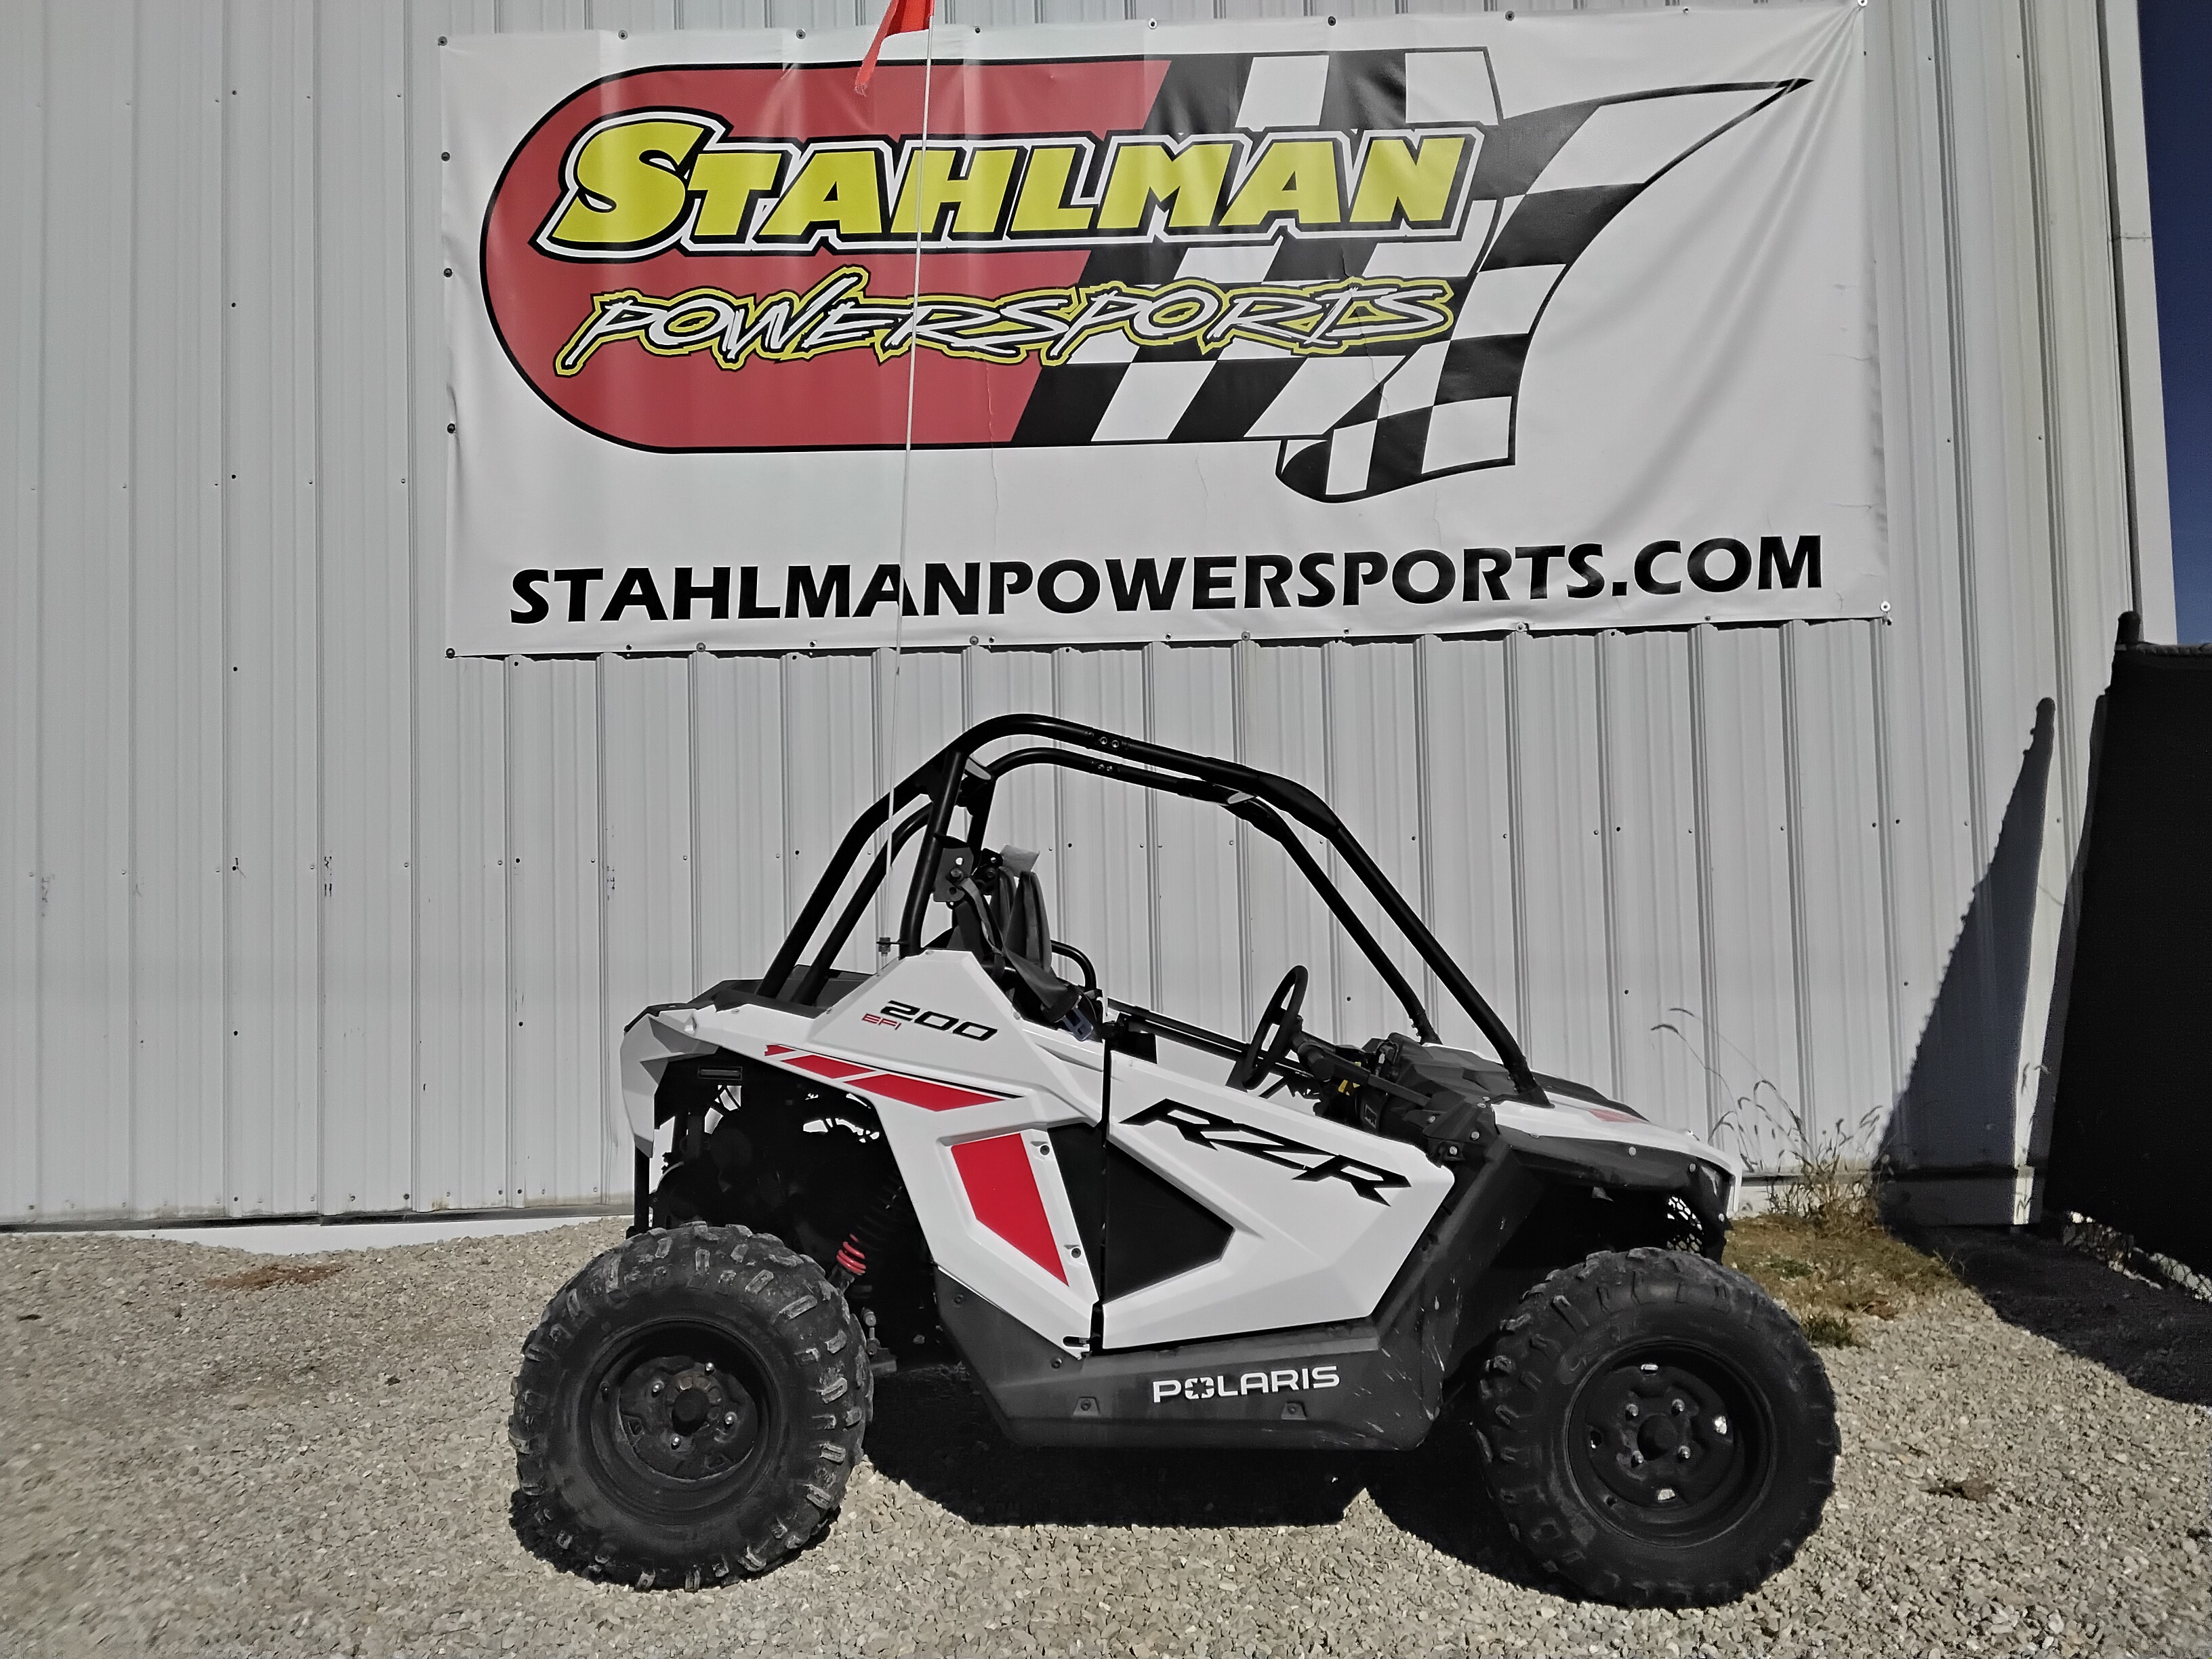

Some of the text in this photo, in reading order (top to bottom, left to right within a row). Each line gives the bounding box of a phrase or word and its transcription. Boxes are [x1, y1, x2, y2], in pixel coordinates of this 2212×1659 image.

[542, 115, 1475, 251] STAHLMAN
[560, 268, 1450, 371] POWERSPORTS
[510, 534, 1822, 625] STAHLMANPOWERSPORTS.COM
[861, 1012, 901, 1031] EFI
[880, 1000, 998, 1042] 200
[1118, 1098, 1412, 1207] RZR
[1153, 1366, 1340, 1403] POLARIS
